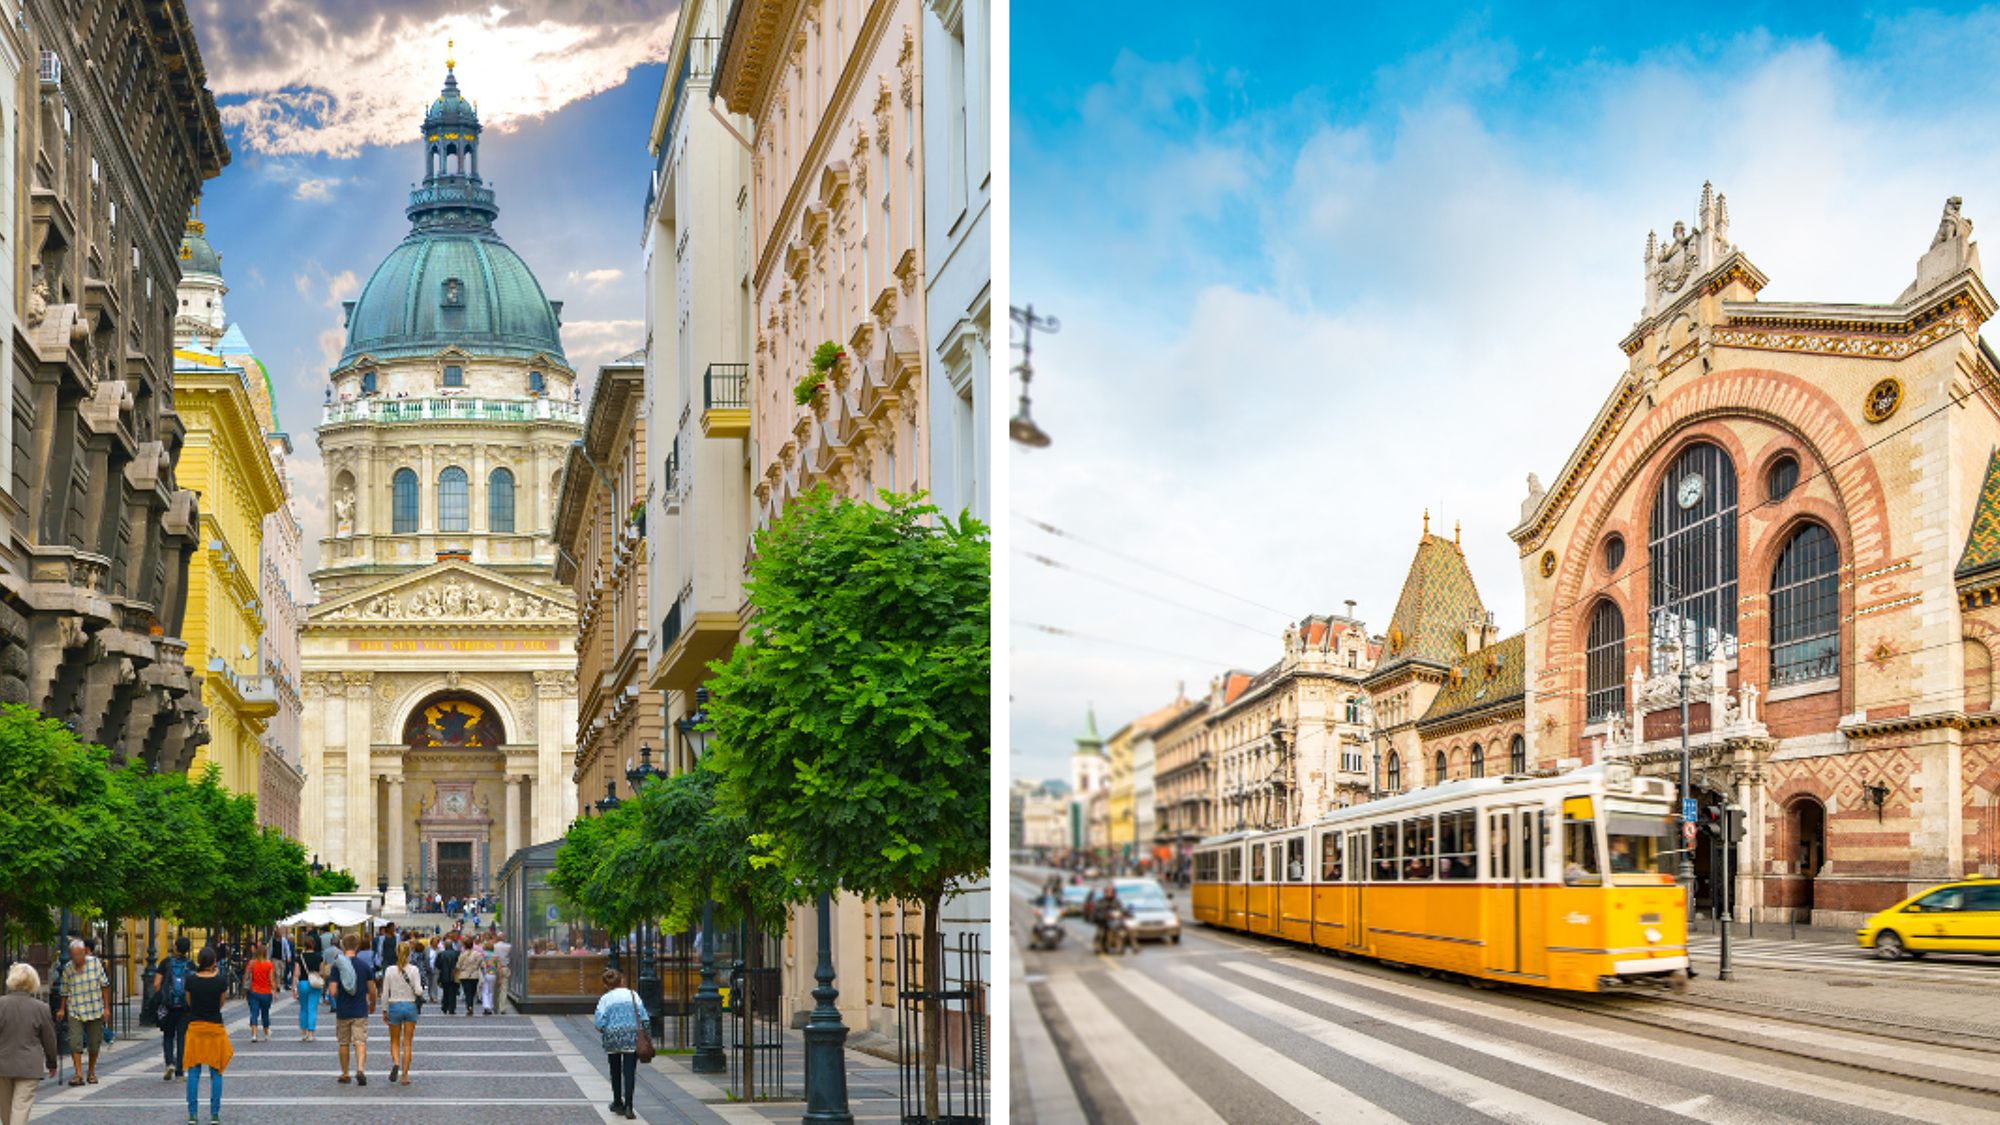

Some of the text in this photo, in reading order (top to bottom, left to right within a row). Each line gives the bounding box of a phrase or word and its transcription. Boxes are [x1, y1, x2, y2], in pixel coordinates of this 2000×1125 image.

[390, 640, 416, 651] SUM
[502, 640, 517, 651] ET
[522, 640, 547, 651] VITA
